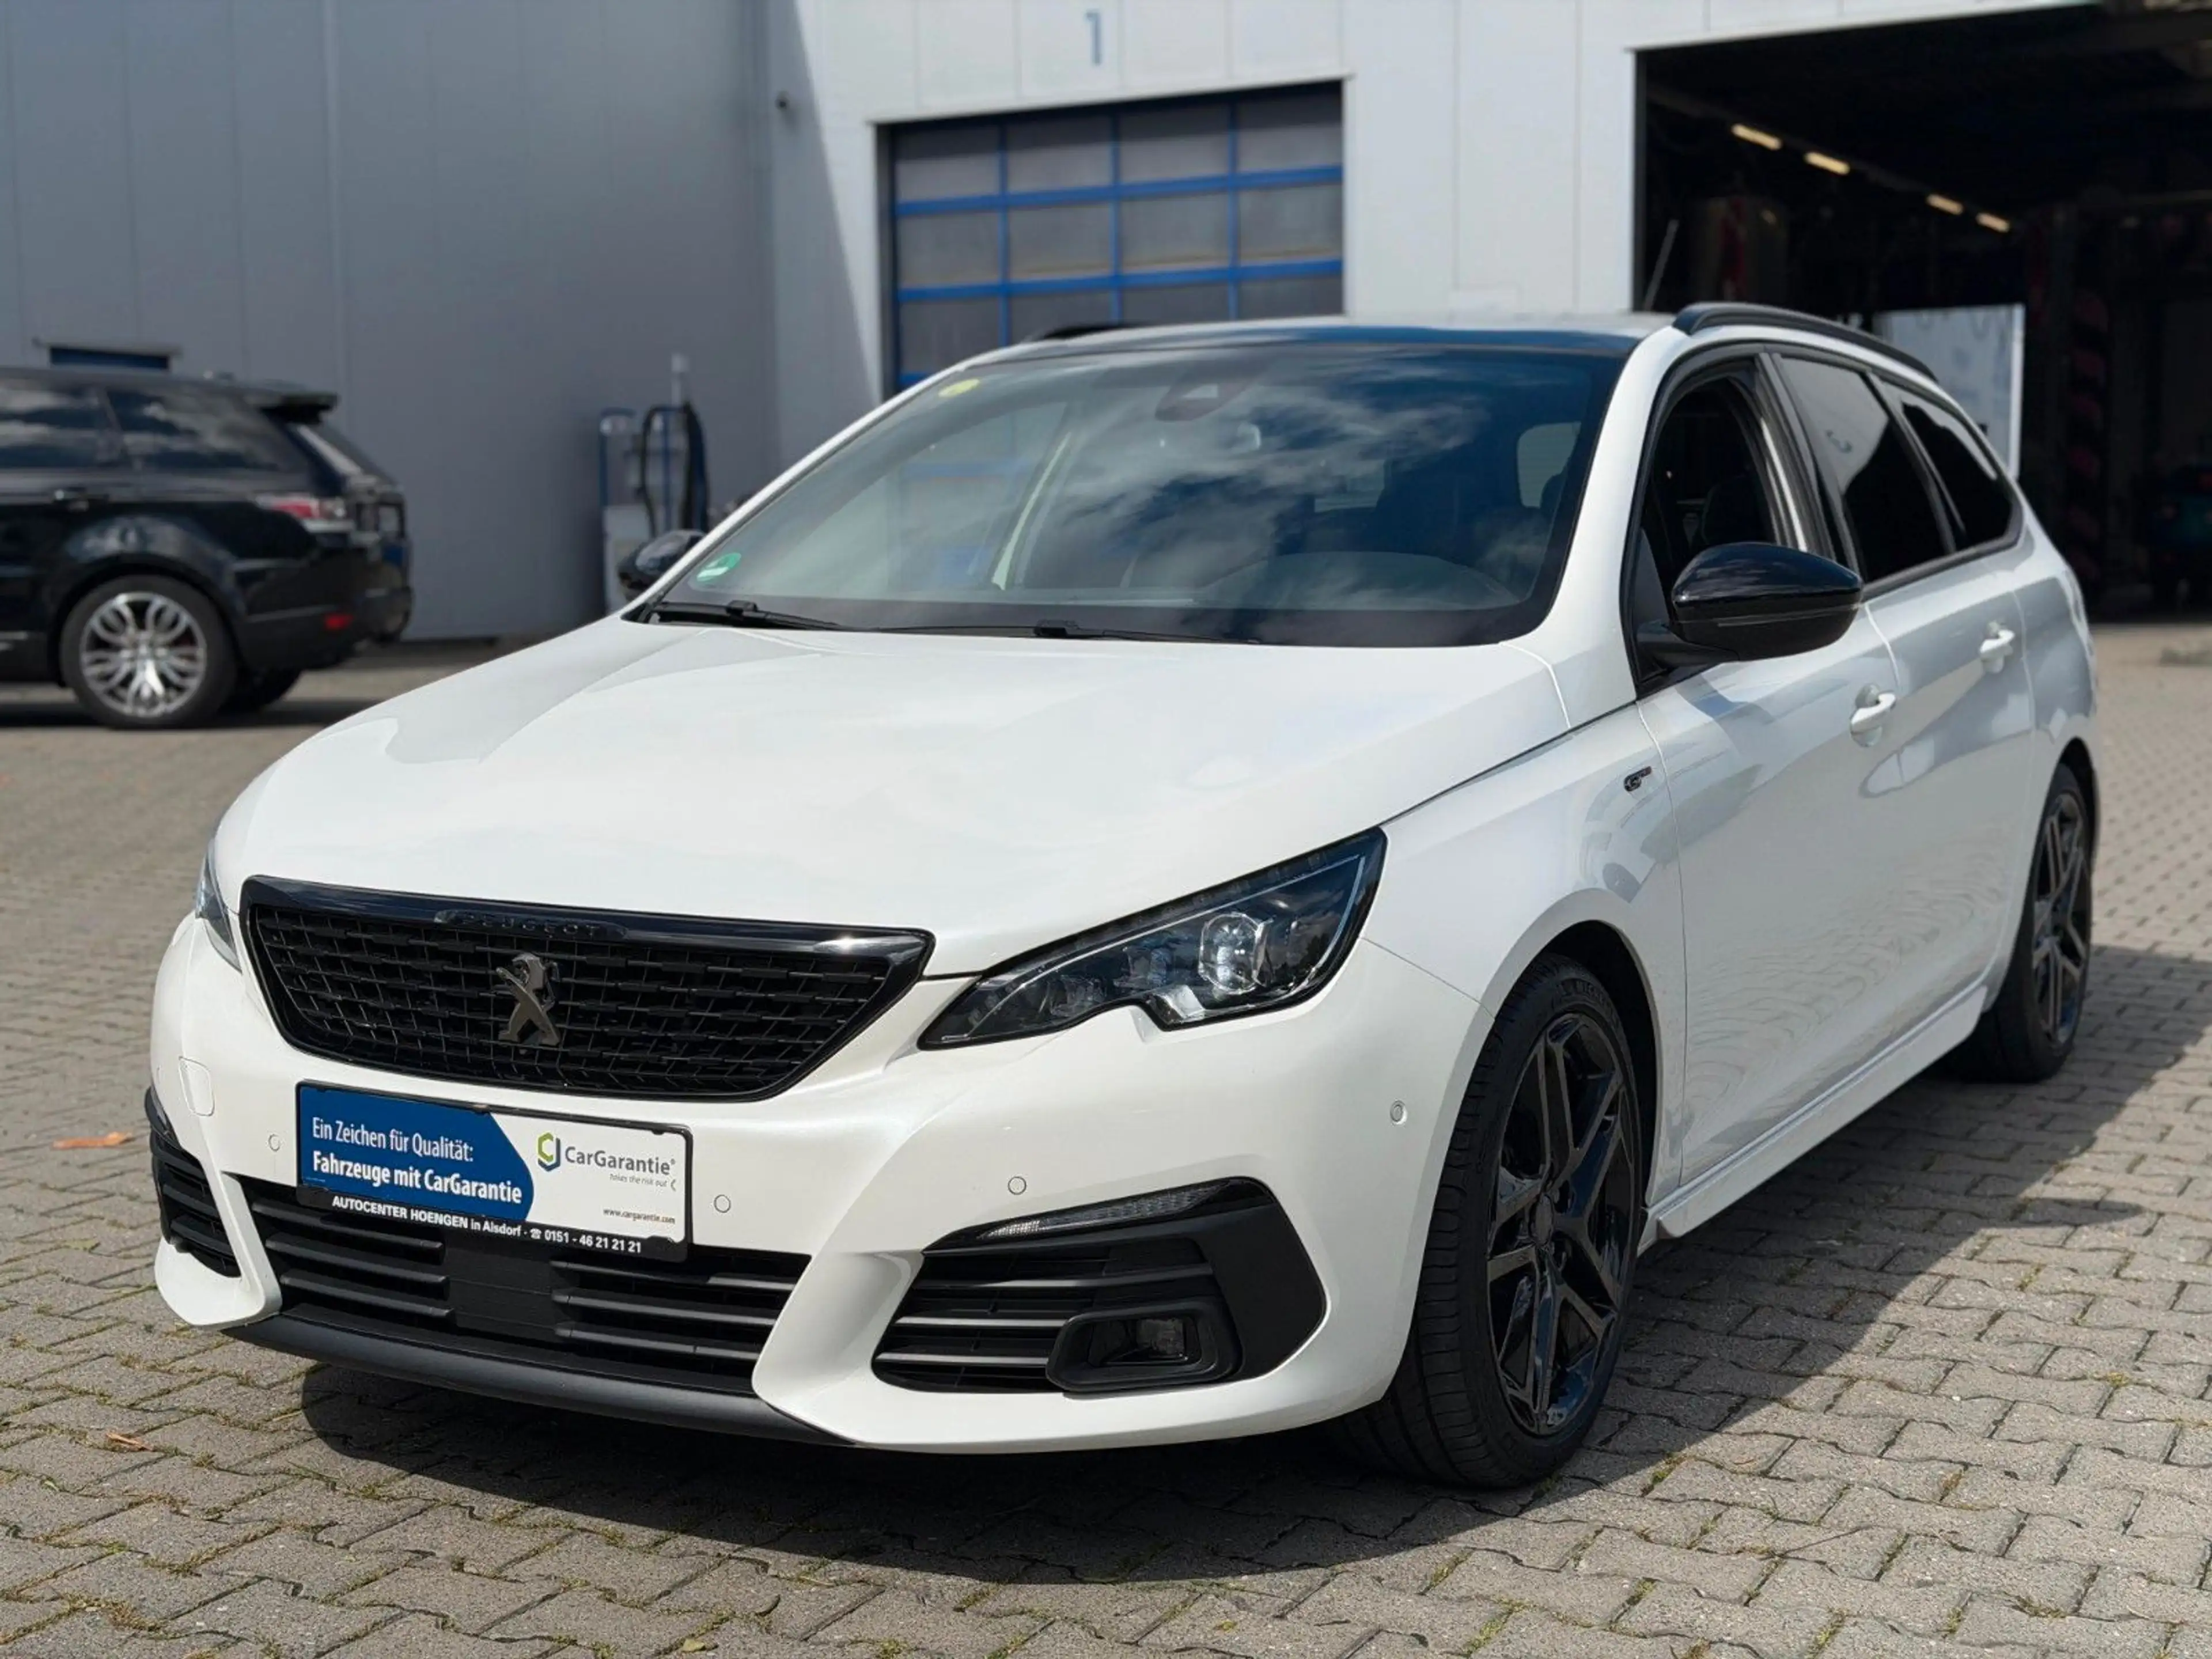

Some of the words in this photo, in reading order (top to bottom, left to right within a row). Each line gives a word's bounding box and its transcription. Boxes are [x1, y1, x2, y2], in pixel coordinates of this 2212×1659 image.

[1086, 10, 1102, 66] 1
[312, 1117, 333, 1140] Ein
[335, 1120, 387, 1149] Zeichen
[389, 1128, 410, 1152] für
[412, 1132, 474, 1162] Qualität:
[313, 1150, 391, 1187] Fahrzeuge
[394, 1166, 422, 1188] mit
[424, 1169, 522, 1204] CarGarantie
[332, 1195, 407, 1219] AUTOCENTER
[410, 1209, 468, 1229] HOENGEN
[471, 1218, 481, 1231] in
[483, 1222, 522, 1237] Alsdorf
[544, 1230, 569, 1244] 0151
[579, 1234, 594, 1247] 46
[596, 1236, 608, 1249] 21
[611, 1238, 625, 1251] 21
[628, 1241, 641, 1253] 21
[603, 1209, 676, 1224] www.cargarantie.com
